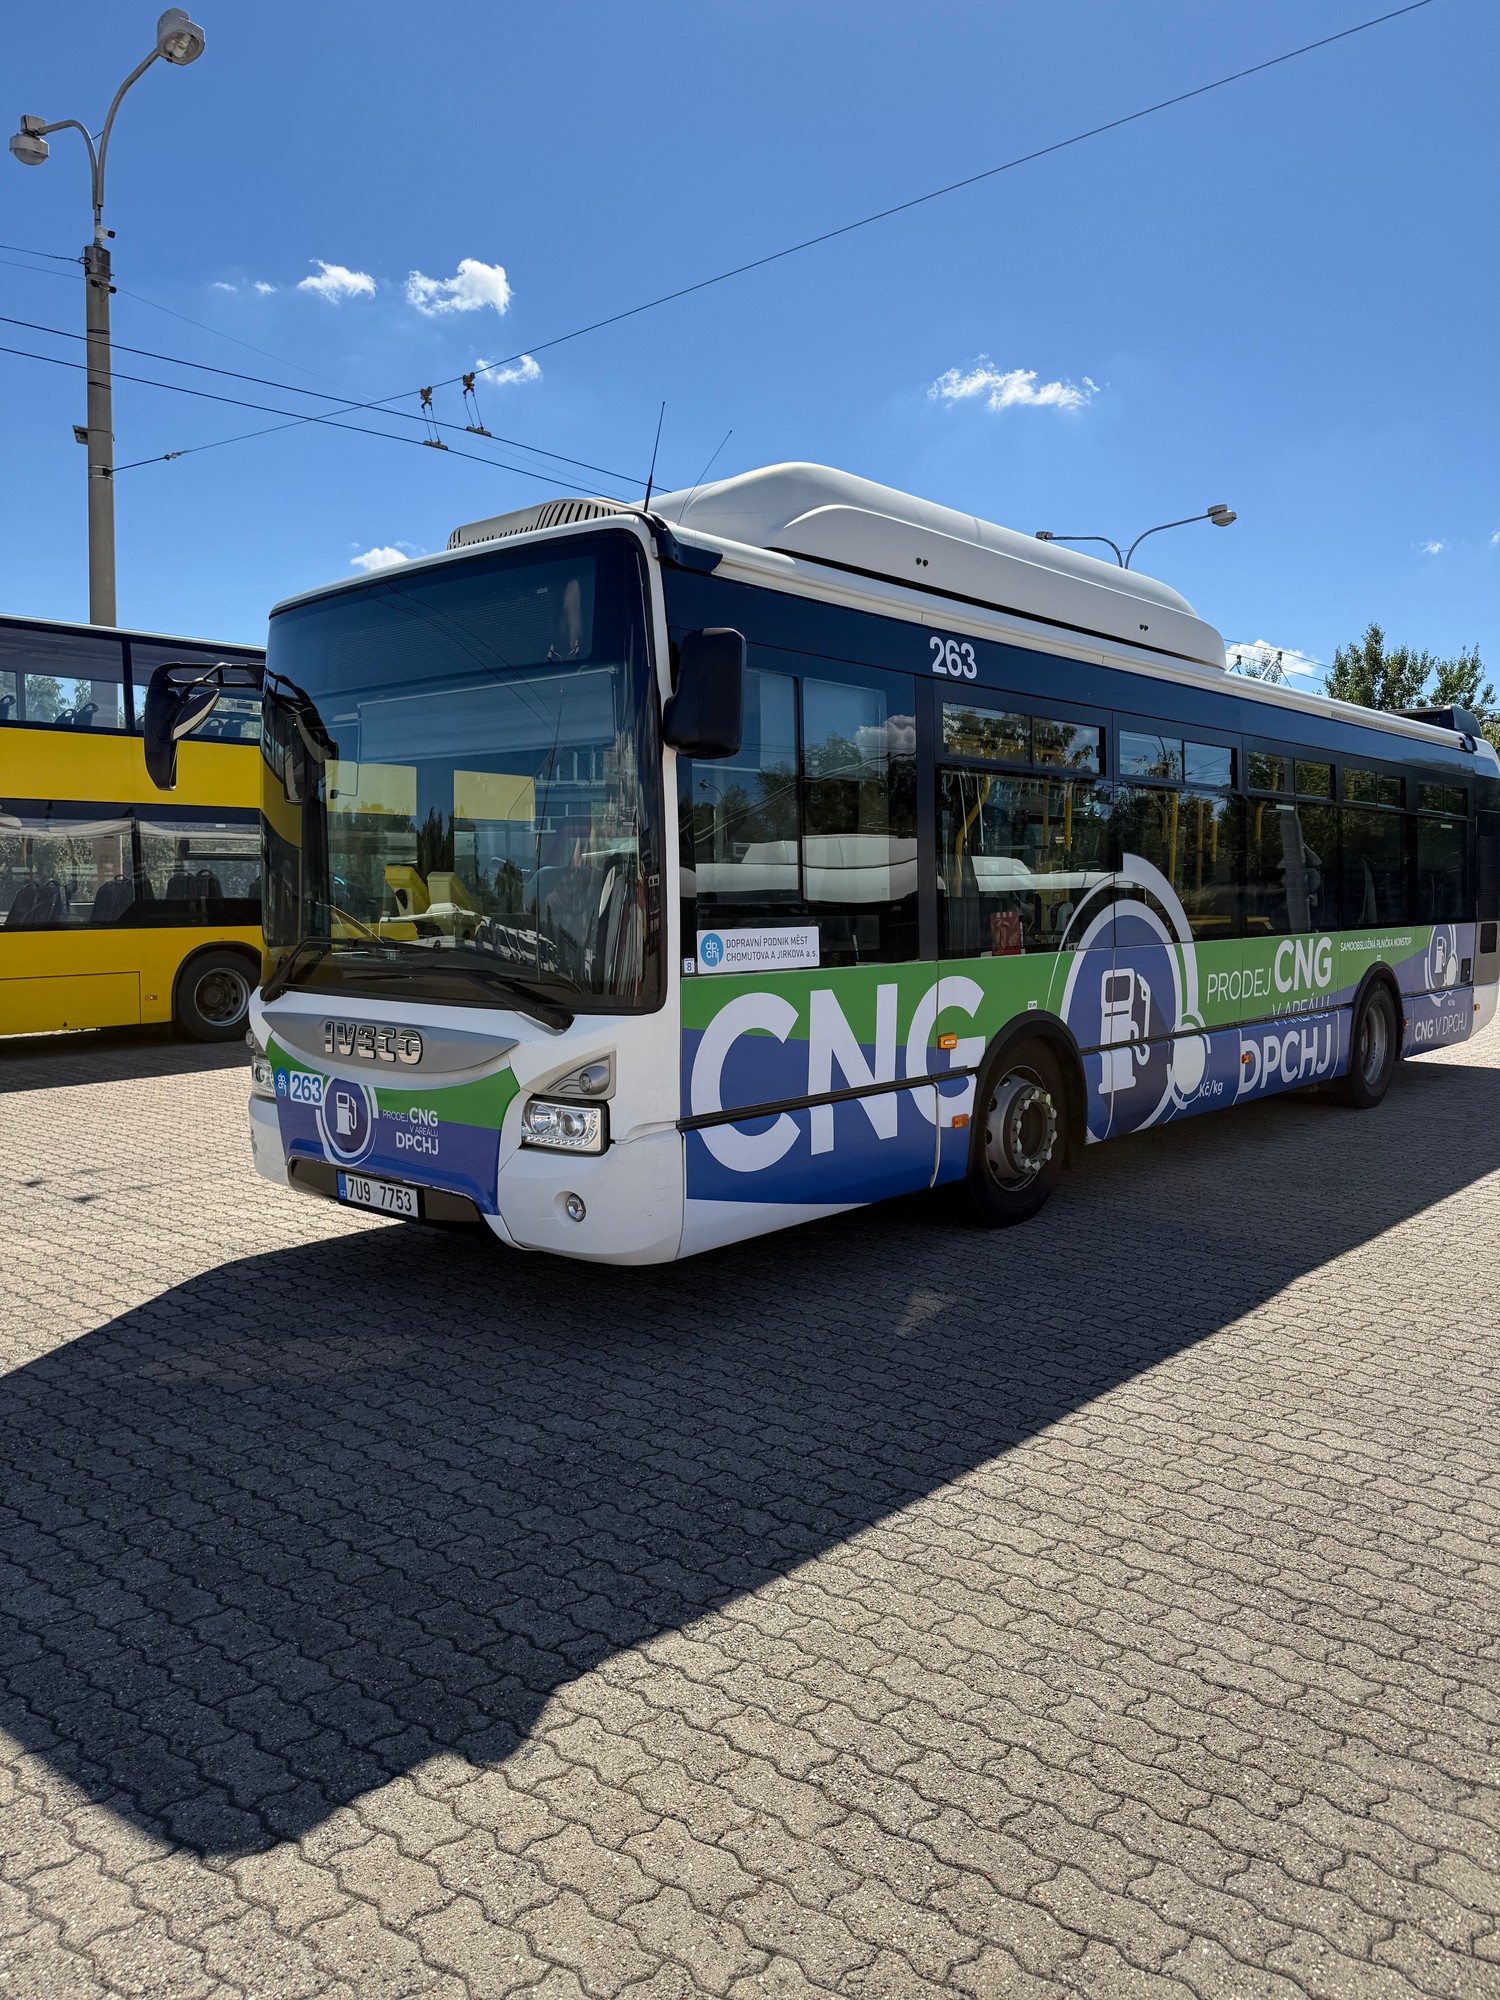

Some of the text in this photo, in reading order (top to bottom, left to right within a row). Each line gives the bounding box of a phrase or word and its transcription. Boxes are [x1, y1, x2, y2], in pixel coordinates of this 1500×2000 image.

[929, 636, 977, 679] 263
[726, 934, 808, 949] DOPRAVNÍ PODNIK MĚST
[726, 950, 770, 962] CHOMUTOVA
[771, 951, 776, 960] A
[777, 949, 804, 959] JIRKOVA
[687, 962, 692, 972] 8
[1207, 936, 1333, 1004] PRODEJ CNG
[1415, 1012, 1468, 1042] CNG V DPCHJ
[324, 1021, 424, 1066] IVECO
[691, 976, 986, 1172] CNG
[1238, 1024, 1332, 1095] DPCHJ
[292, 1073, 322, 1104] 263
[1200, 1080, 1223, 1097] Kč/kg
[383, 1106, 438, 1128] PRODEJ CNG
[409, 1125, 438, 1138] V AREÁLU
[396, 1131, 439, 1156] DPCHJ
[340, 1177, 412, 1212] CZ 7U9 7753
